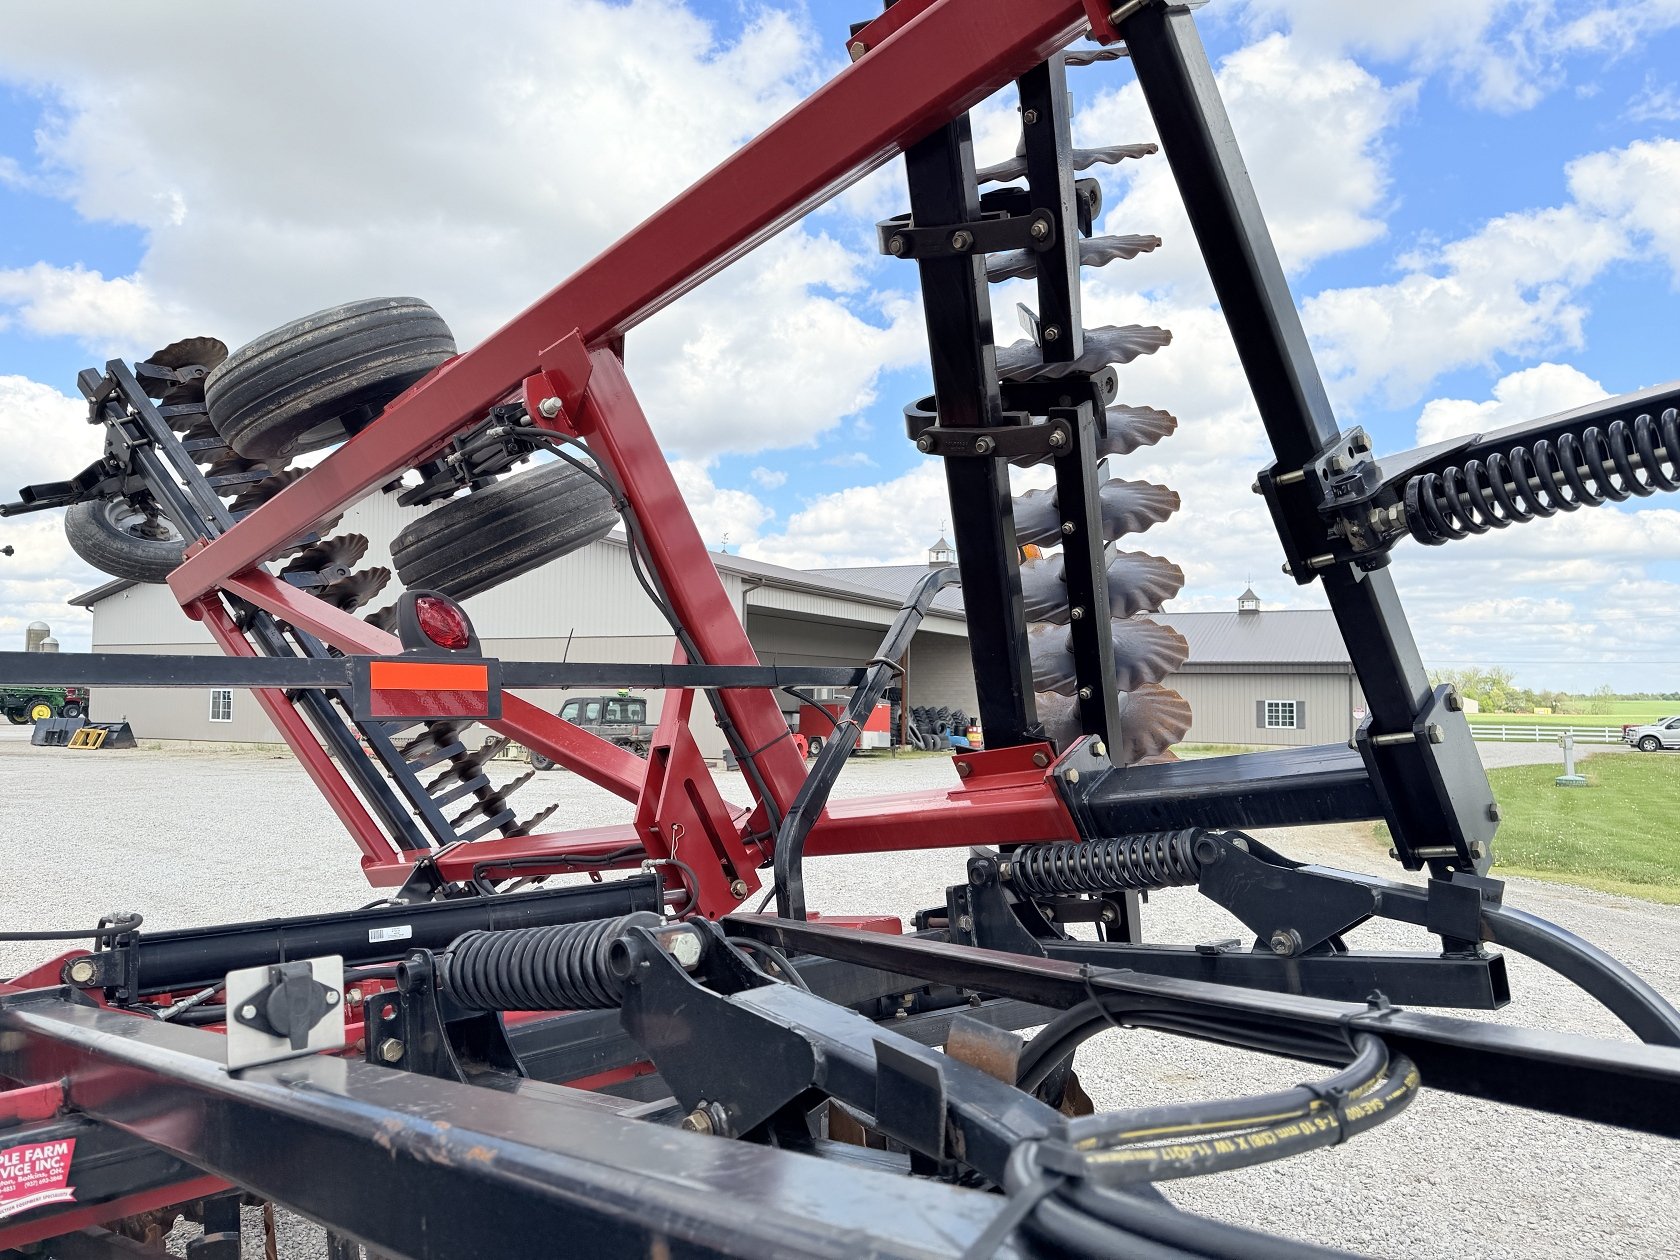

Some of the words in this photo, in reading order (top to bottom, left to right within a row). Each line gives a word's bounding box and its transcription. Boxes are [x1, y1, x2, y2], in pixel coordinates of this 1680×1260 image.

[1275, 1125, 1300, 1139] mm
[1234, 1136, 1249, 1150] X
[25, 1143, 68, 1162] FARM
[35, 1156, 65, 1172] INC.
[17, 1172, 48, 1182] Botkins,
[49, 1167, 64, 1176] OH.
